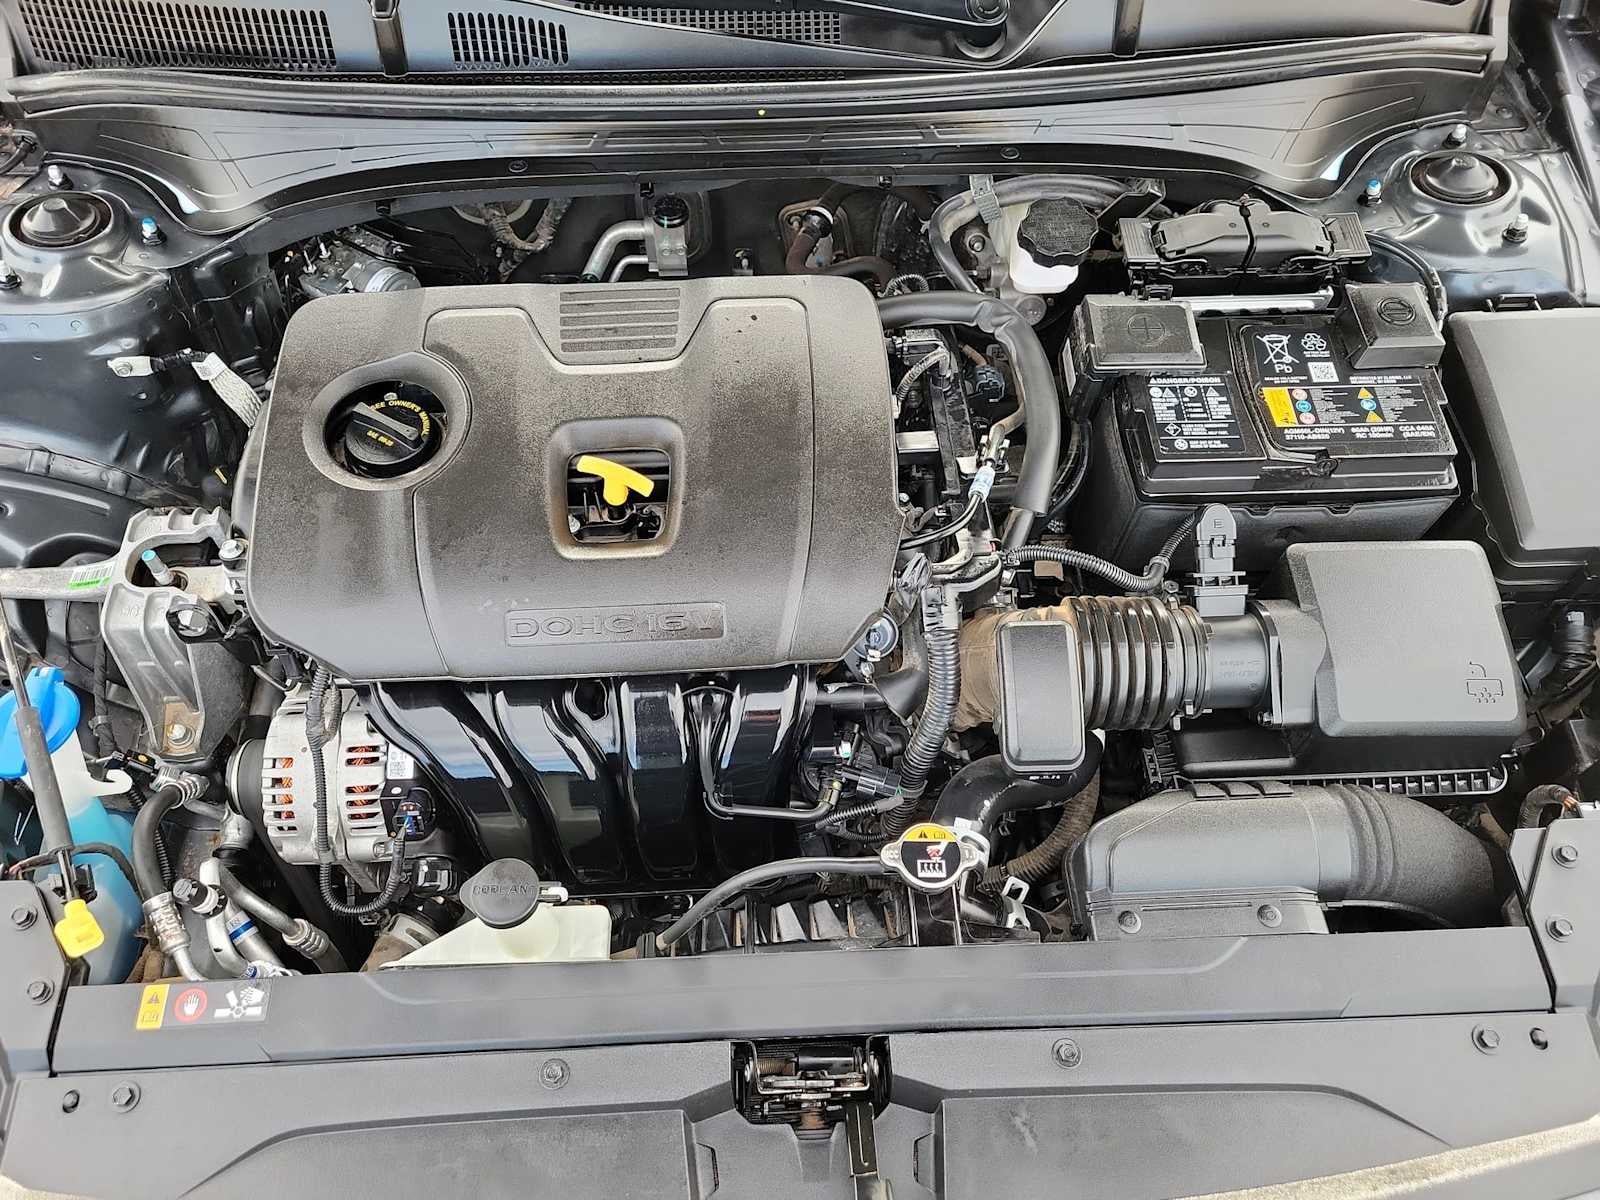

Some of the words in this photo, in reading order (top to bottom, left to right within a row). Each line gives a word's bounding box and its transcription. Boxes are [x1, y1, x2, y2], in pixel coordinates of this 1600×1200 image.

[1274, 363, 1293, 373] Pb
[388, 400, 421, 413] OWNER'S
[508, 613, 636, 638] DOHC
[648, 608, 714, 633] 16V
[472, 883, 536, 897] COOLANT
